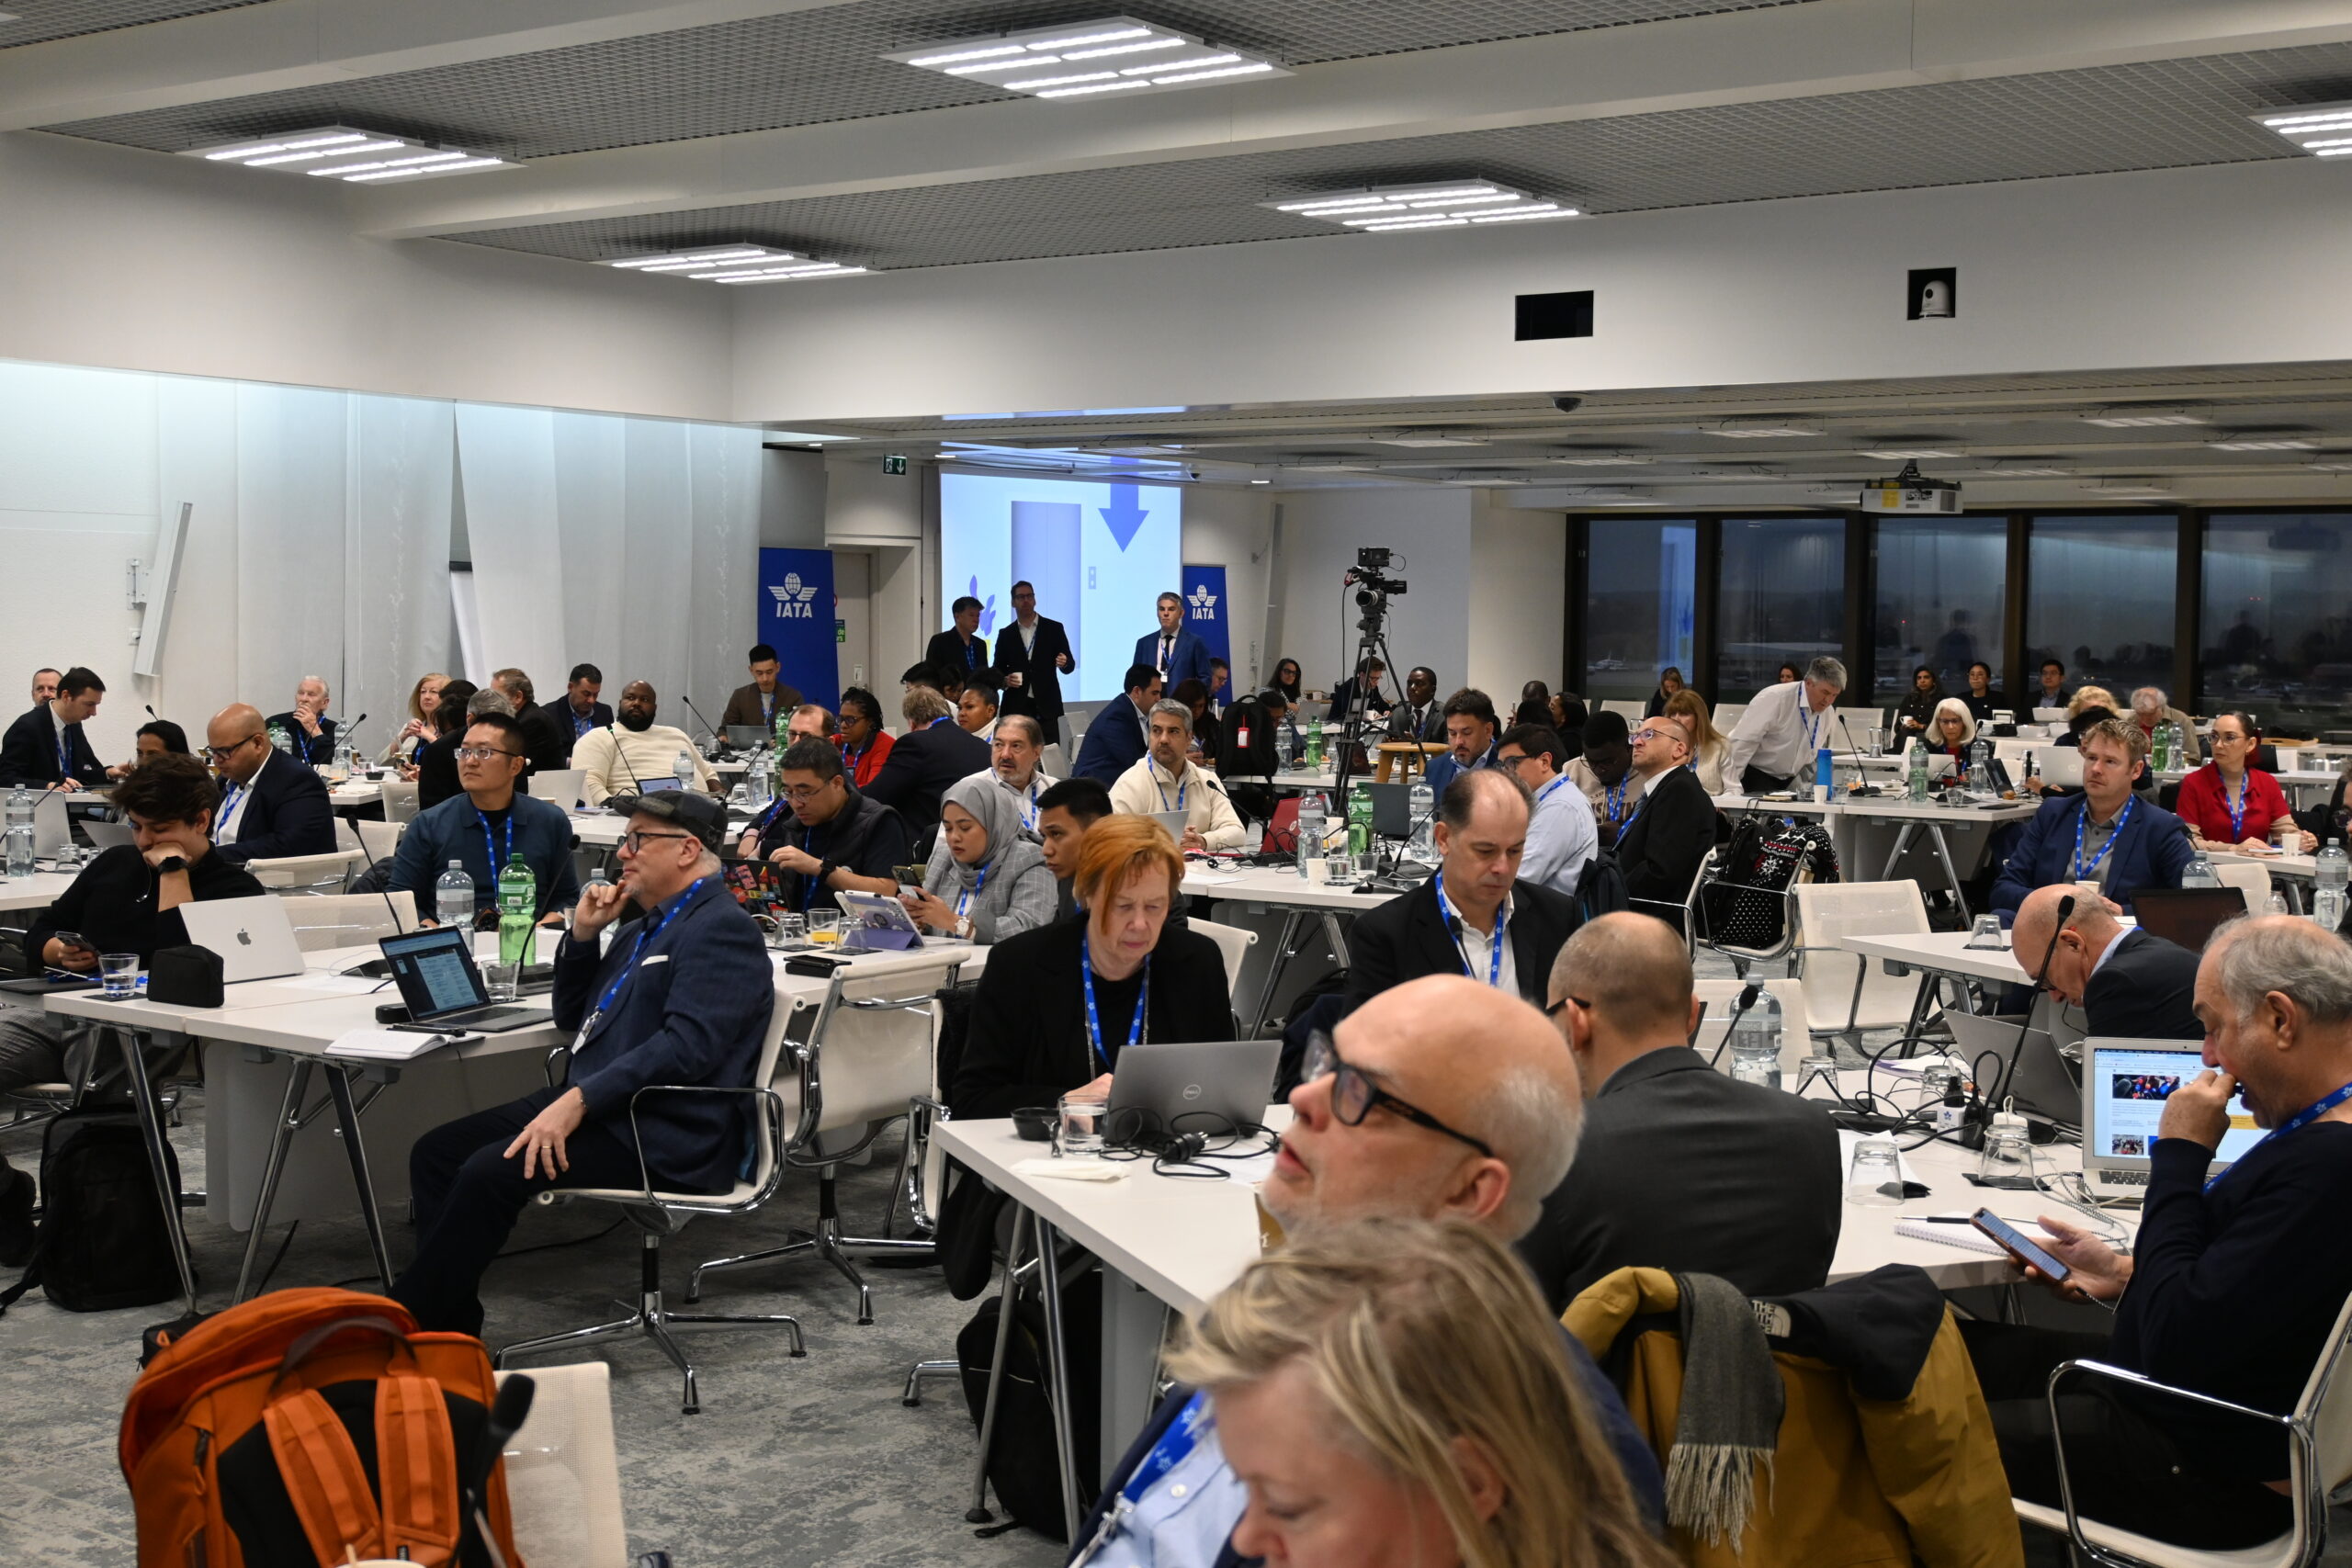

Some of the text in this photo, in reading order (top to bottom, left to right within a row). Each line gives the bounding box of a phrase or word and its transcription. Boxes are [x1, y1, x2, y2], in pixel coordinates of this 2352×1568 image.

[776, 602, 813, 618] IATA
[1192, 607, 1215, 620] IATA
[1752, 1300, 1775, 1314] THE
